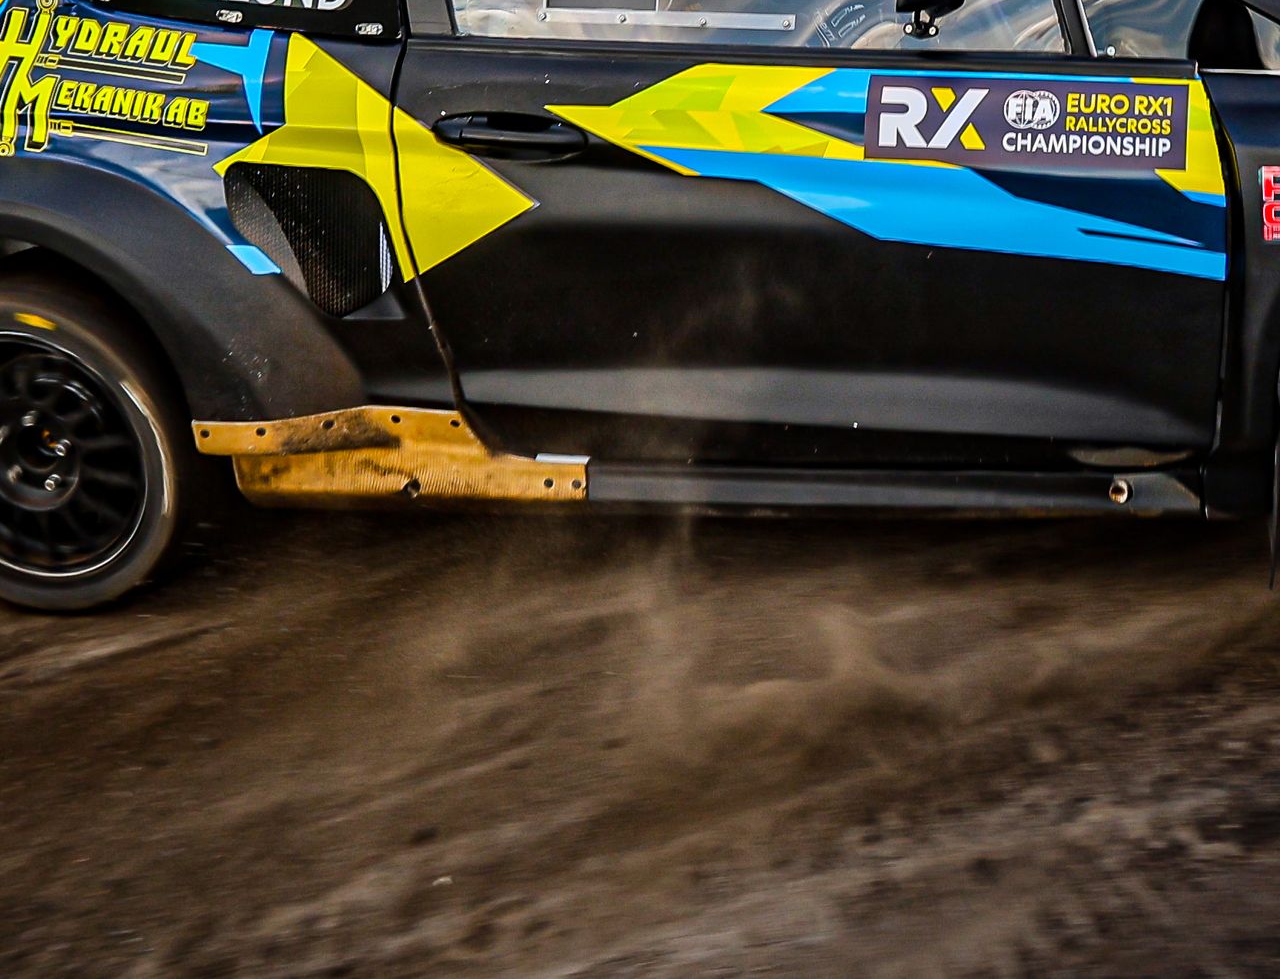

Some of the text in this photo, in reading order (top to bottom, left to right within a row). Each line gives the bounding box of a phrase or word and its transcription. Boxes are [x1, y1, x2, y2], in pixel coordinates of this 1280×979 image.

[163, 96, 210, 131] AB
[878, 85, 990, 151] RX
[1066, 93, 1174, 117] EURO RX1
[1065, 115, 1172, 136] RALLYCROSS
[1001, 132, 1172, 159] CHAMPIONSHIP
